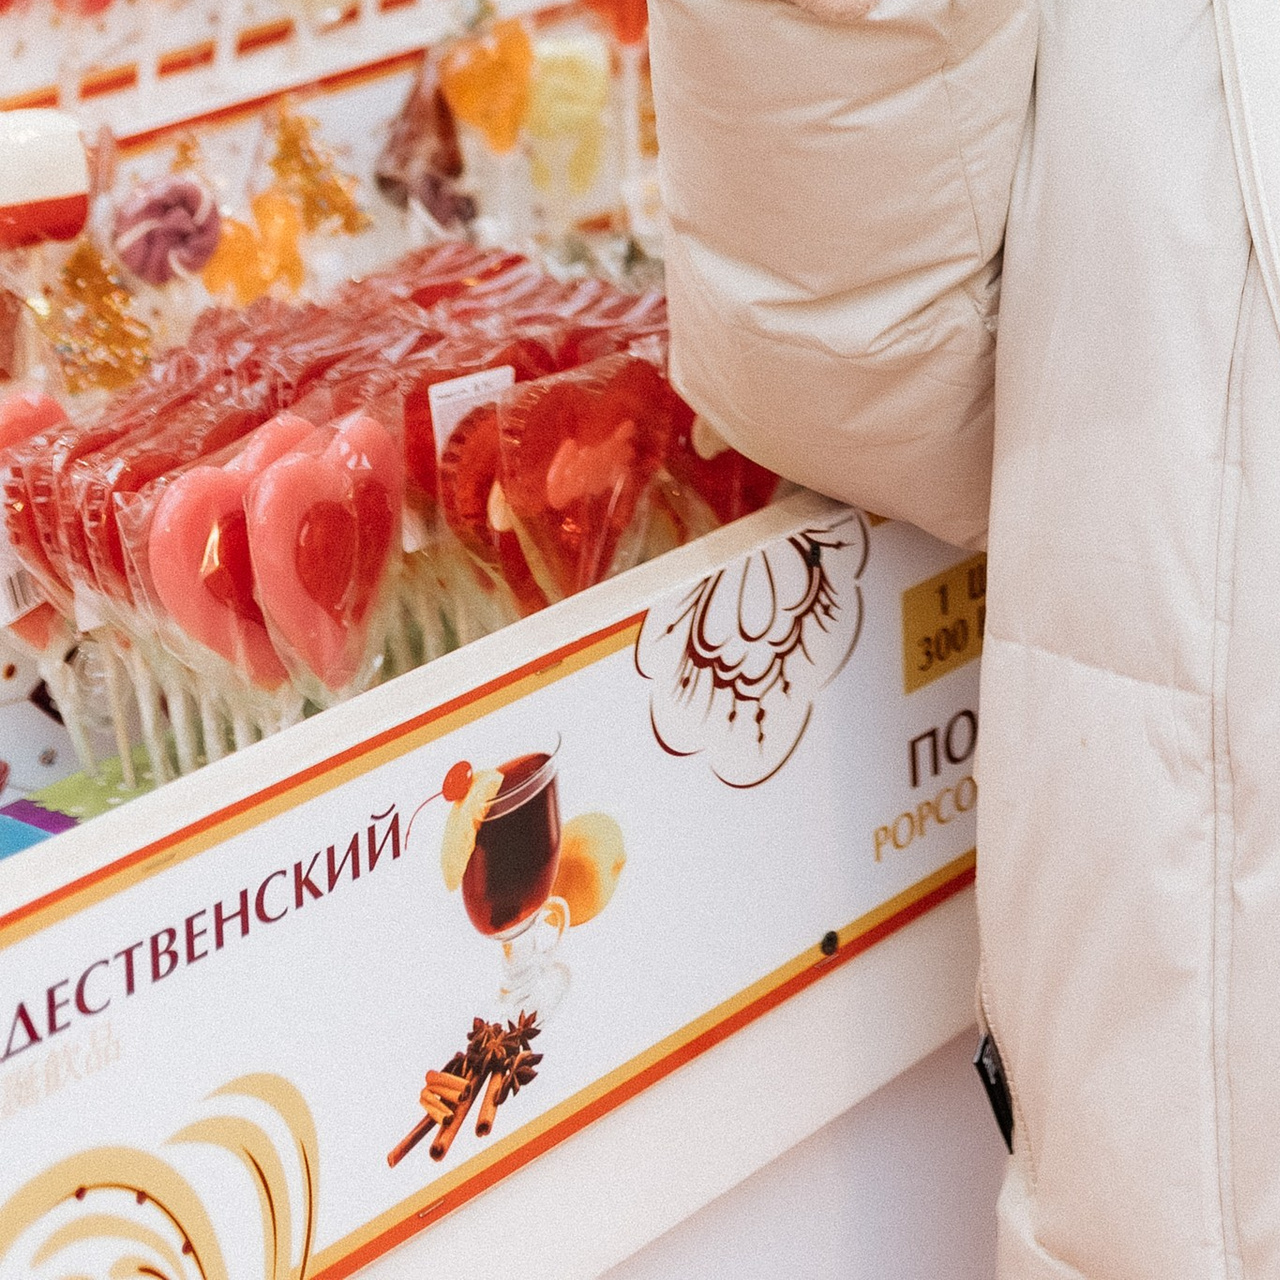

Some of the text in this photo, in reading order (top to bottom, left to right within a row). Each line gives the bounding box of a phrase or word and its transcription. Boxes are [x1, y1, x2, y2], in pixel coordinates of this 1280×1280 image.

[936, 582, 949, 616] 1
[917, 618, 969, 672] 300
[909, 709, 979, 789] ПО
[873, 775, 978, 864] POPCO
[0, 803, 402, 1064] ДЕСТВЕНСКИЙ
